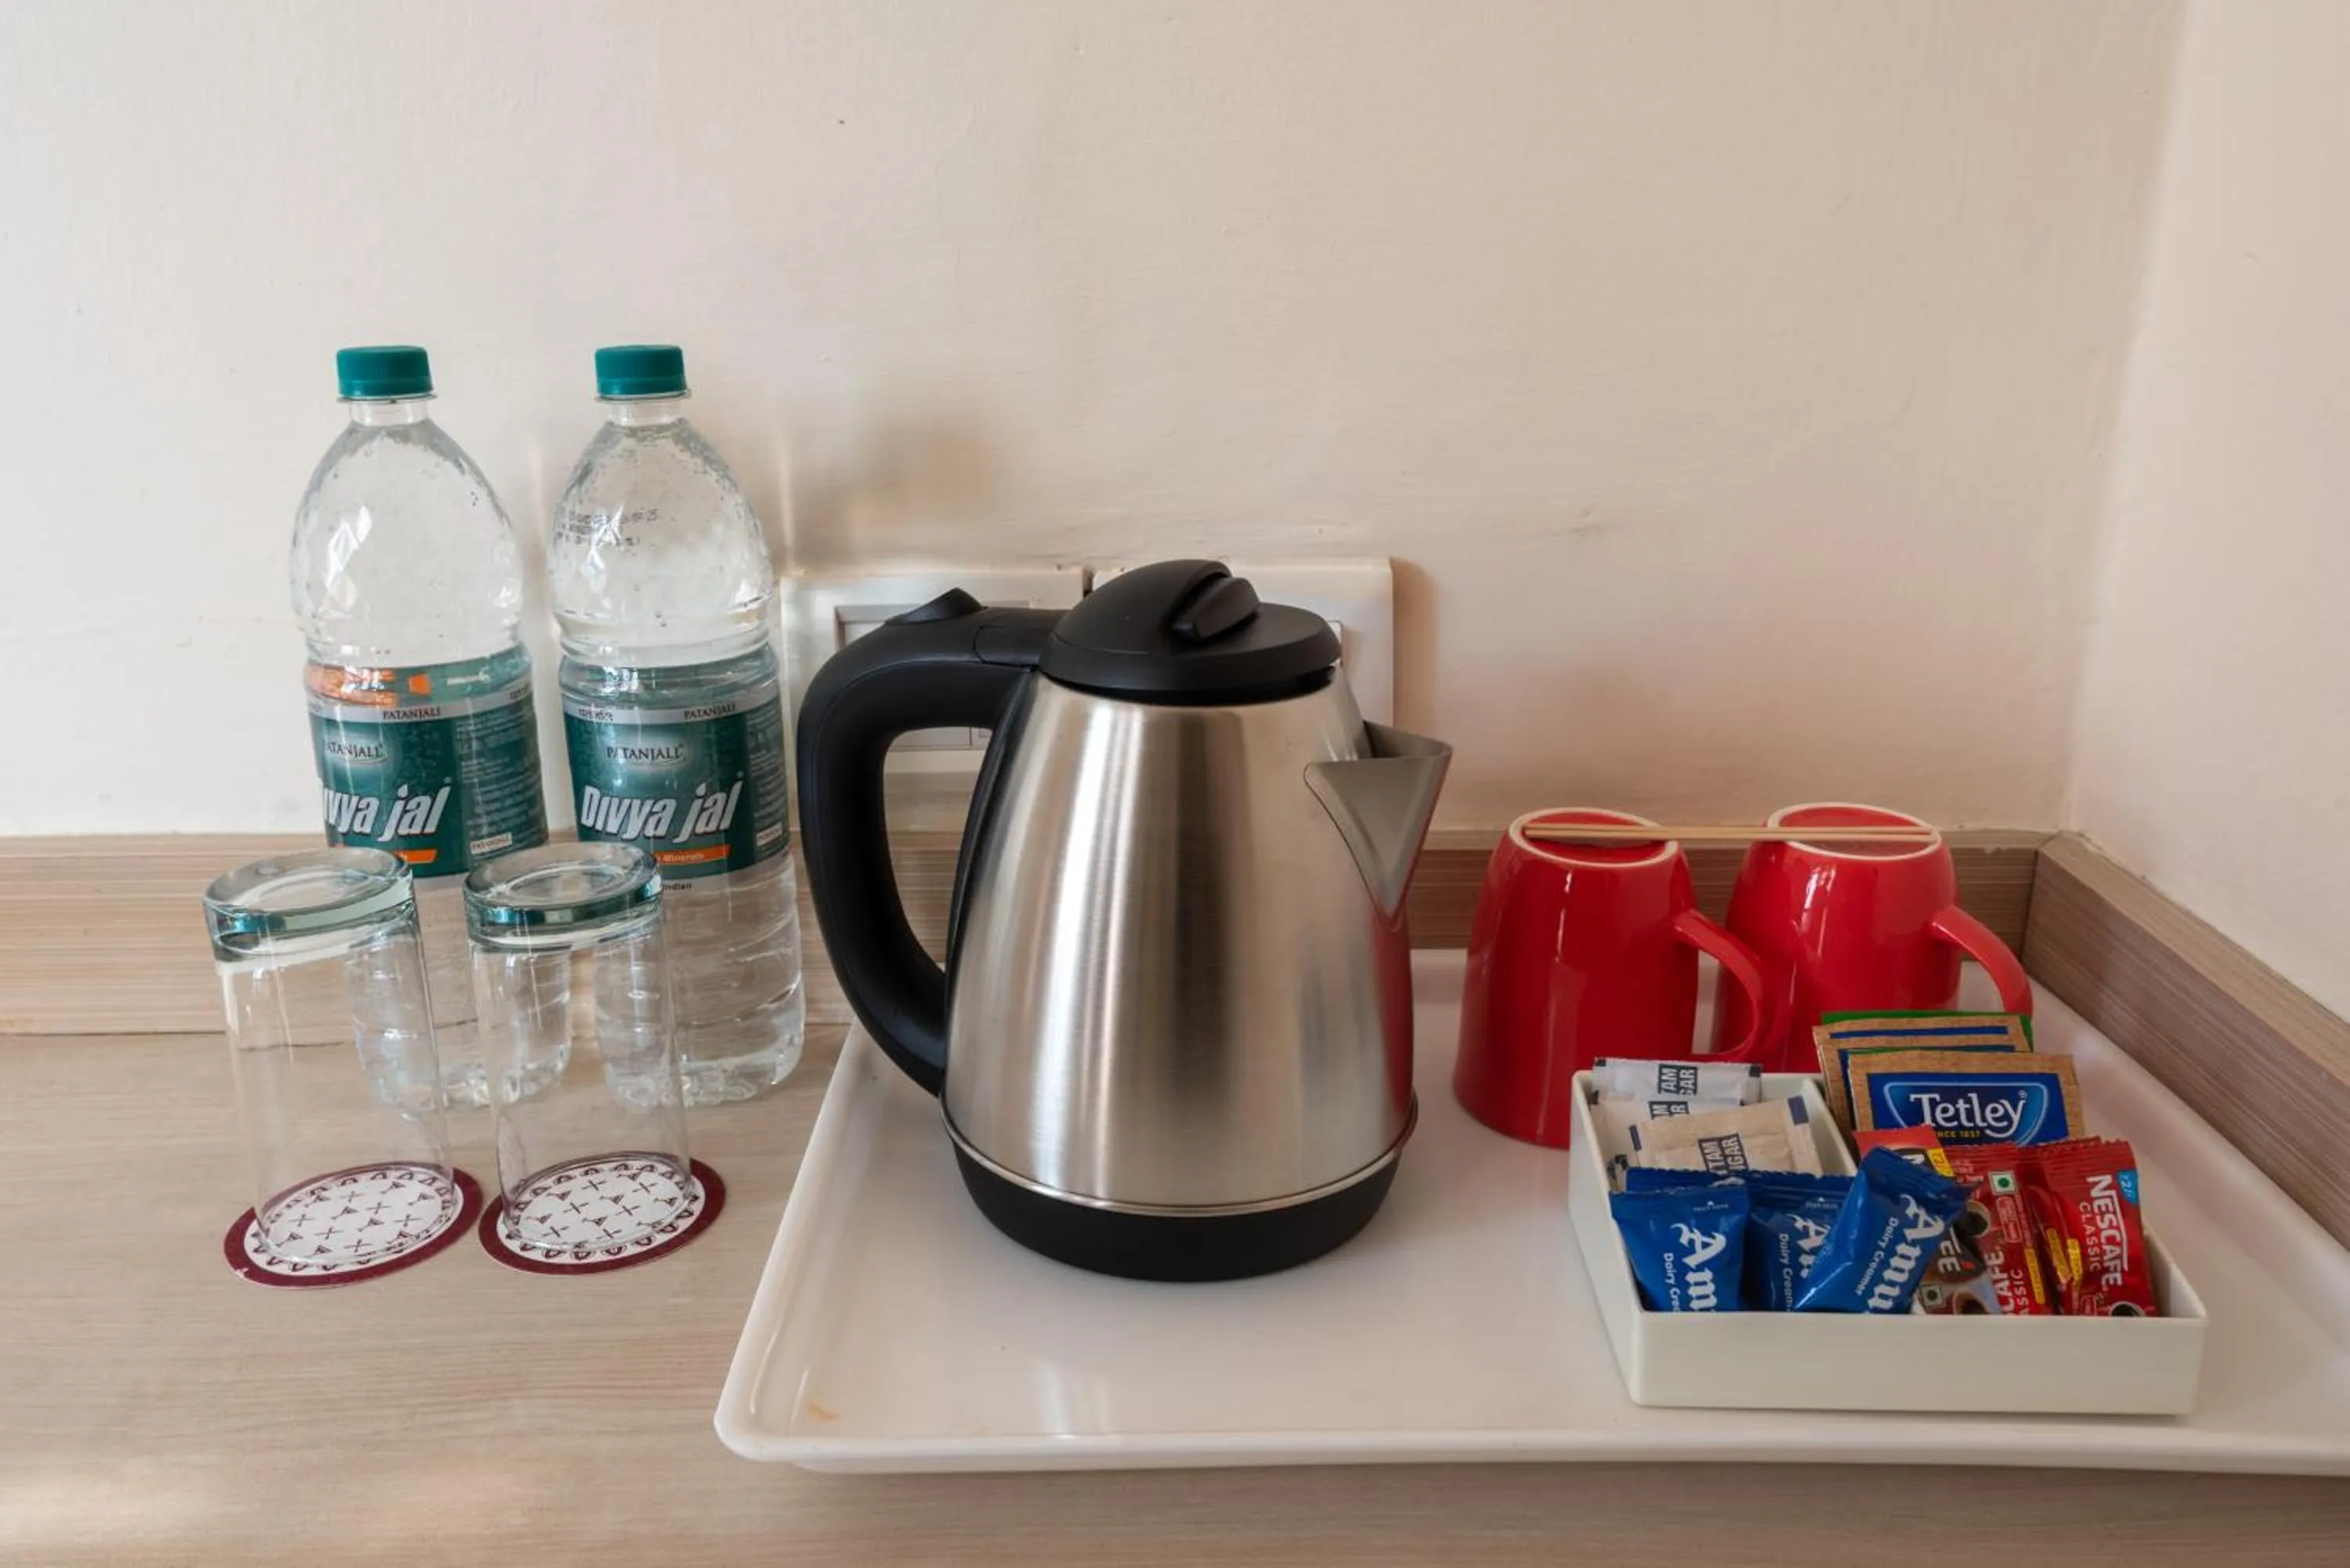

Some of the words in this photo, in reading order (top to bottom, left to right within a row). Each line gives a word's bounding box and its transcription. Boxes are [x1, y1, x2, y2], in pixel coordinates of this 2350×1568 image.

[325, 742, 383, 759] ATANJALI
[376, 783, 452, 843] jal
[580, 785, 677, 841] Divya
[672, 780, 743, 844] jal
[1909, 1092, 2027, 1138] Tetley
[1865, 1194, 1944, 1313] Amu
[1878, 1216, 1900, 1249] Dairy
[2080, 1202, 2102, 1272] CLASSIC
[1663, 1252, 1677, 1285] Dairy
[1670, 1223, 1728, 1312] Am
